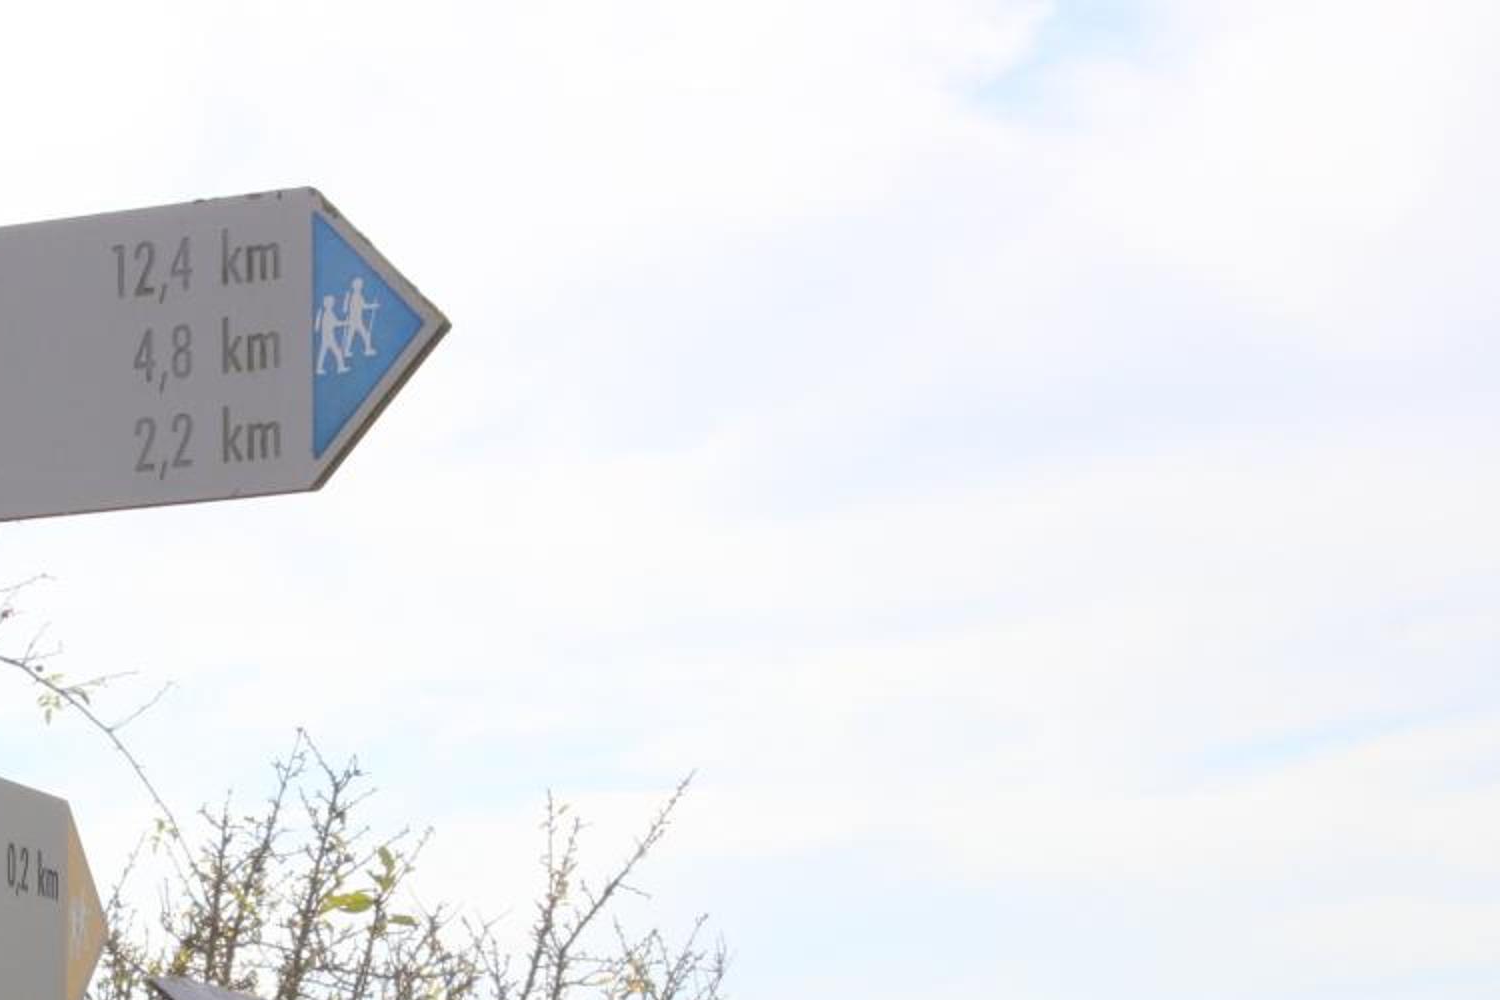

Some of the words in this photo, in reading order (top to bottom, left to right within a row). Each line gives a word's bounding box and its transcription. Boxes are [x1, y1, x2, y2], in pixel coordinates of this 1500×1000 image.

[112, 237, 191, 303] 12,4
[222, 229, 281, 286] km
[134, 325, 192, 393] 4,8
[222, 317, 280, 374] km
[134, 413, 193, 479] 2,2
[223, 407, 280, 463] km
[7, 843, 29, 896] 0,2
[38, 851, 59, 900] km
